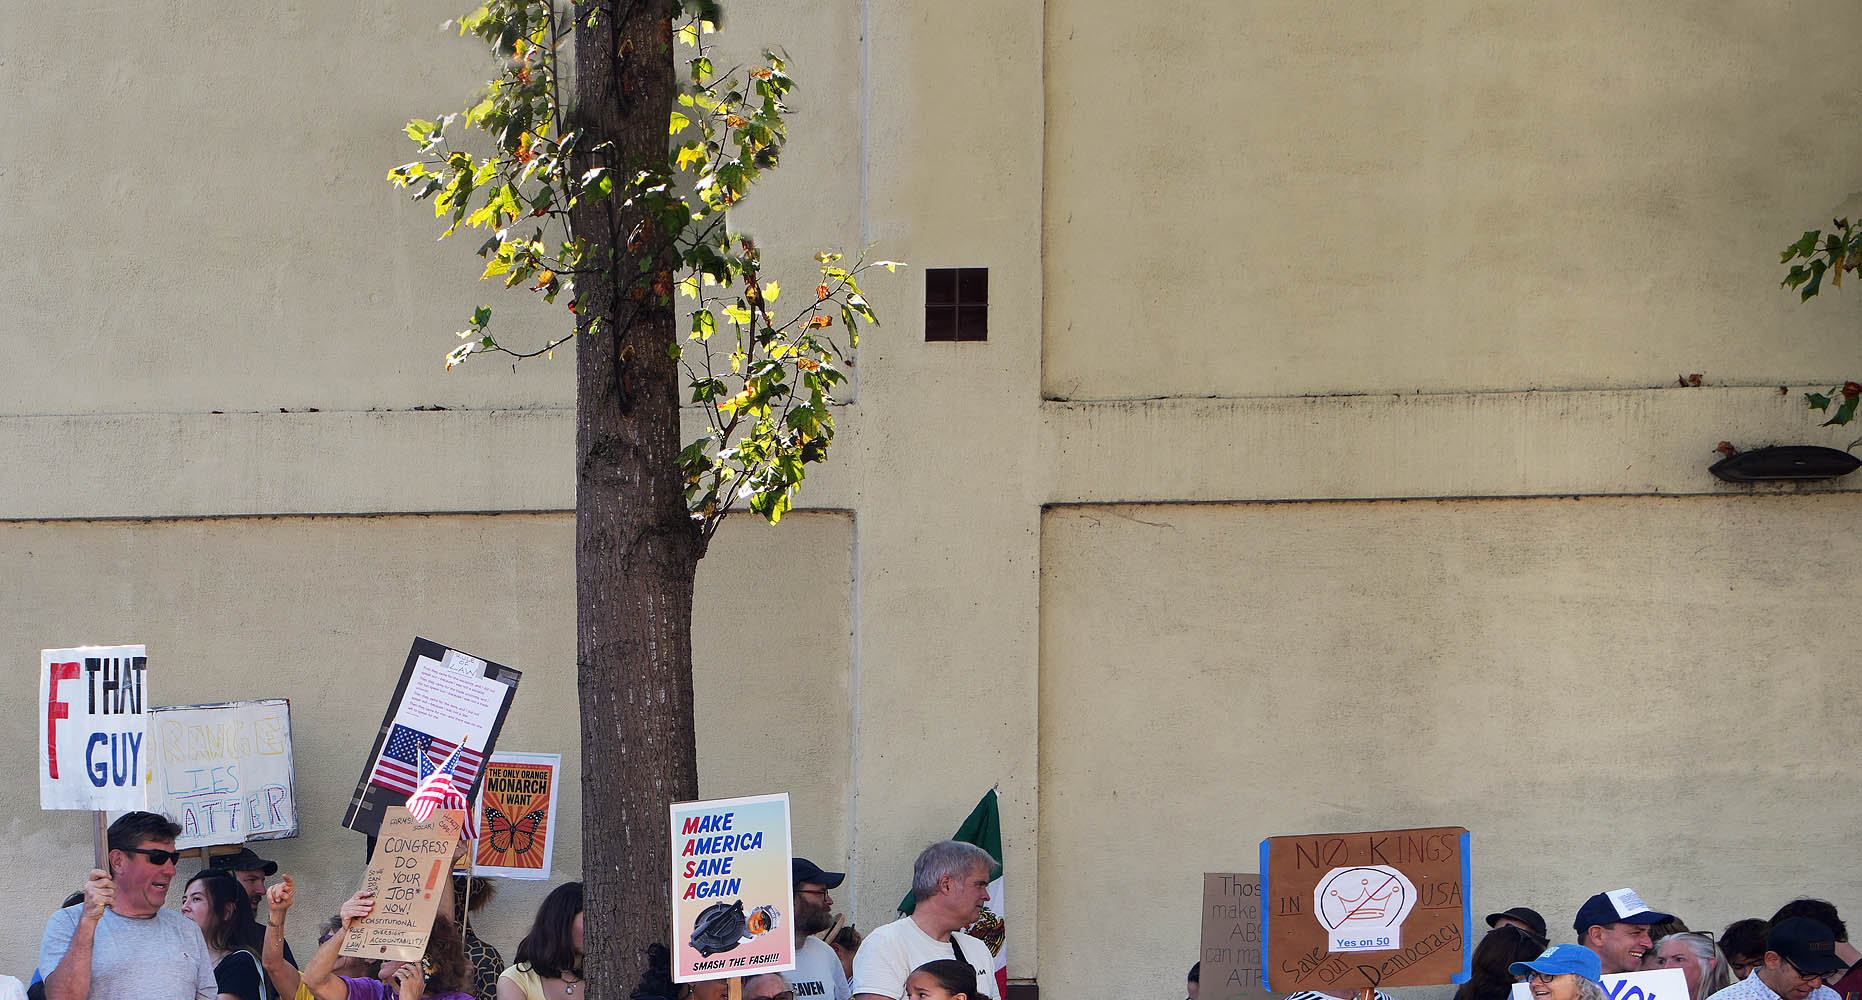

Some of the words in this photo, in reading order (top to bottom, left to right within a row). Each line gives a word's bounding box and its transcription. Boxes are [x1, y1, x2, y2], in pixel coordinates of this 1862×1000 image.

[47, 662, 80, 780] F
[85, 656, 147, 715] THAT
[86, 731, 142, 787] GUY
[165, 766, 239, 794] LIES
[489, 768, 502, 778] THE
[503, 769, 519, 779] ONLY
[521, 770, 548, 780] ORANGE
[487, 778, 547, 794] MONARCH
[506, 794, 532, 806] WANT
[682, 812, 734, 835] MAKE
[384, 838, 449, 853] CONGRESS
[682, 831, 763, 857] AMERICA
[1369, 834, 1454, 866] KINGS
[395, 856, 418, 869] DO
[683, 857, 733, 879] SANE
[393, 873, 420, 885] YOUR
[683, 878, 742, 900] AGAIN
[1280, 896, 1301, 914] IN
[1420, 881, 1462, 907] USA
[1212, 904, 1257, 920] make
[369, 935, 428, 946] ACCOUNTABILITY!
[372, 929, 406, 937] OVERSIGHT
[1337, 938, 1357, 947] Yes
[1359, 939, 1374, 947] on
[1376, 937, 1390, 946] 50
[692, 960, 725, 972] SMASH
[729, 958, 746, 968] THE
[749, 953, 779, 966] FASH!!!
[1206, 948, 1235, 964] can
[1282, 946, 1328, 982] Save
[1356, 923, 1462, 987] Democracy
[1318, 956, 1349, 982] our
